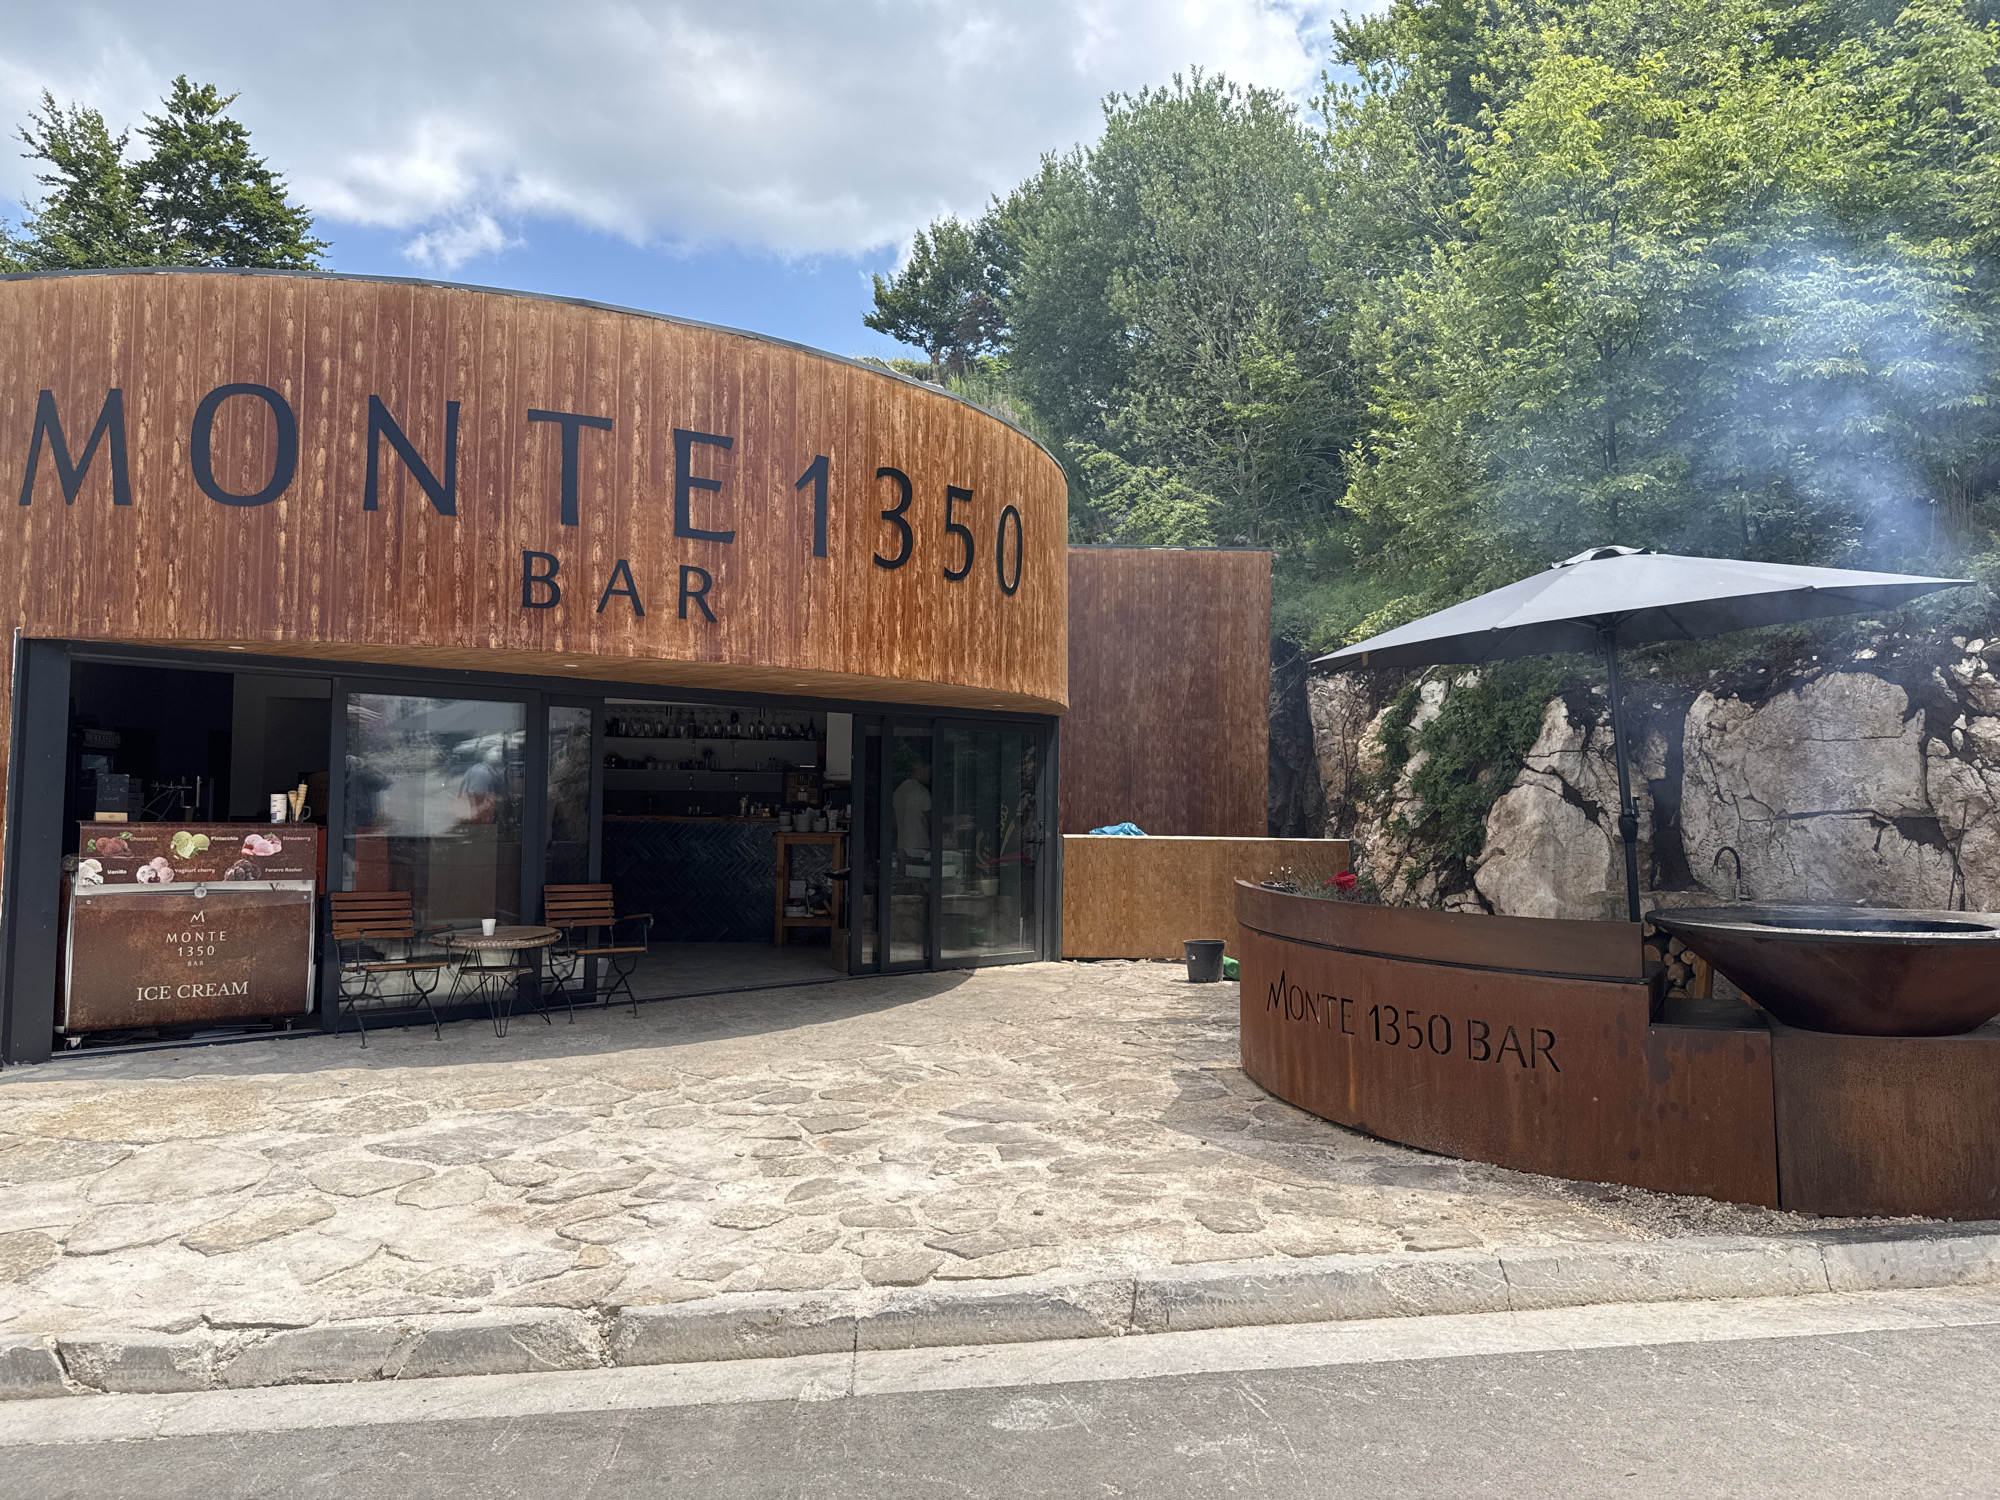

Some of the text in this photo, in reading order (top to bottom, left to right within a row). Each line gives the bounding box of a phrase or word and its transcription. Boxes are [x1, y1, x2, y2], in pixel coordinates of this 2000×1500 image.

[19, 383, 1022, 596] MONTE 1350
[522, 550, 718, 623] BAR
[165, 931, 227, 943] MONTE
[177, 945, 215, 957] 1350
[136, 981, 249, 1001] ICE CREAM
[1266, 969, 1561, 1073] MONTE 1350 BAR
